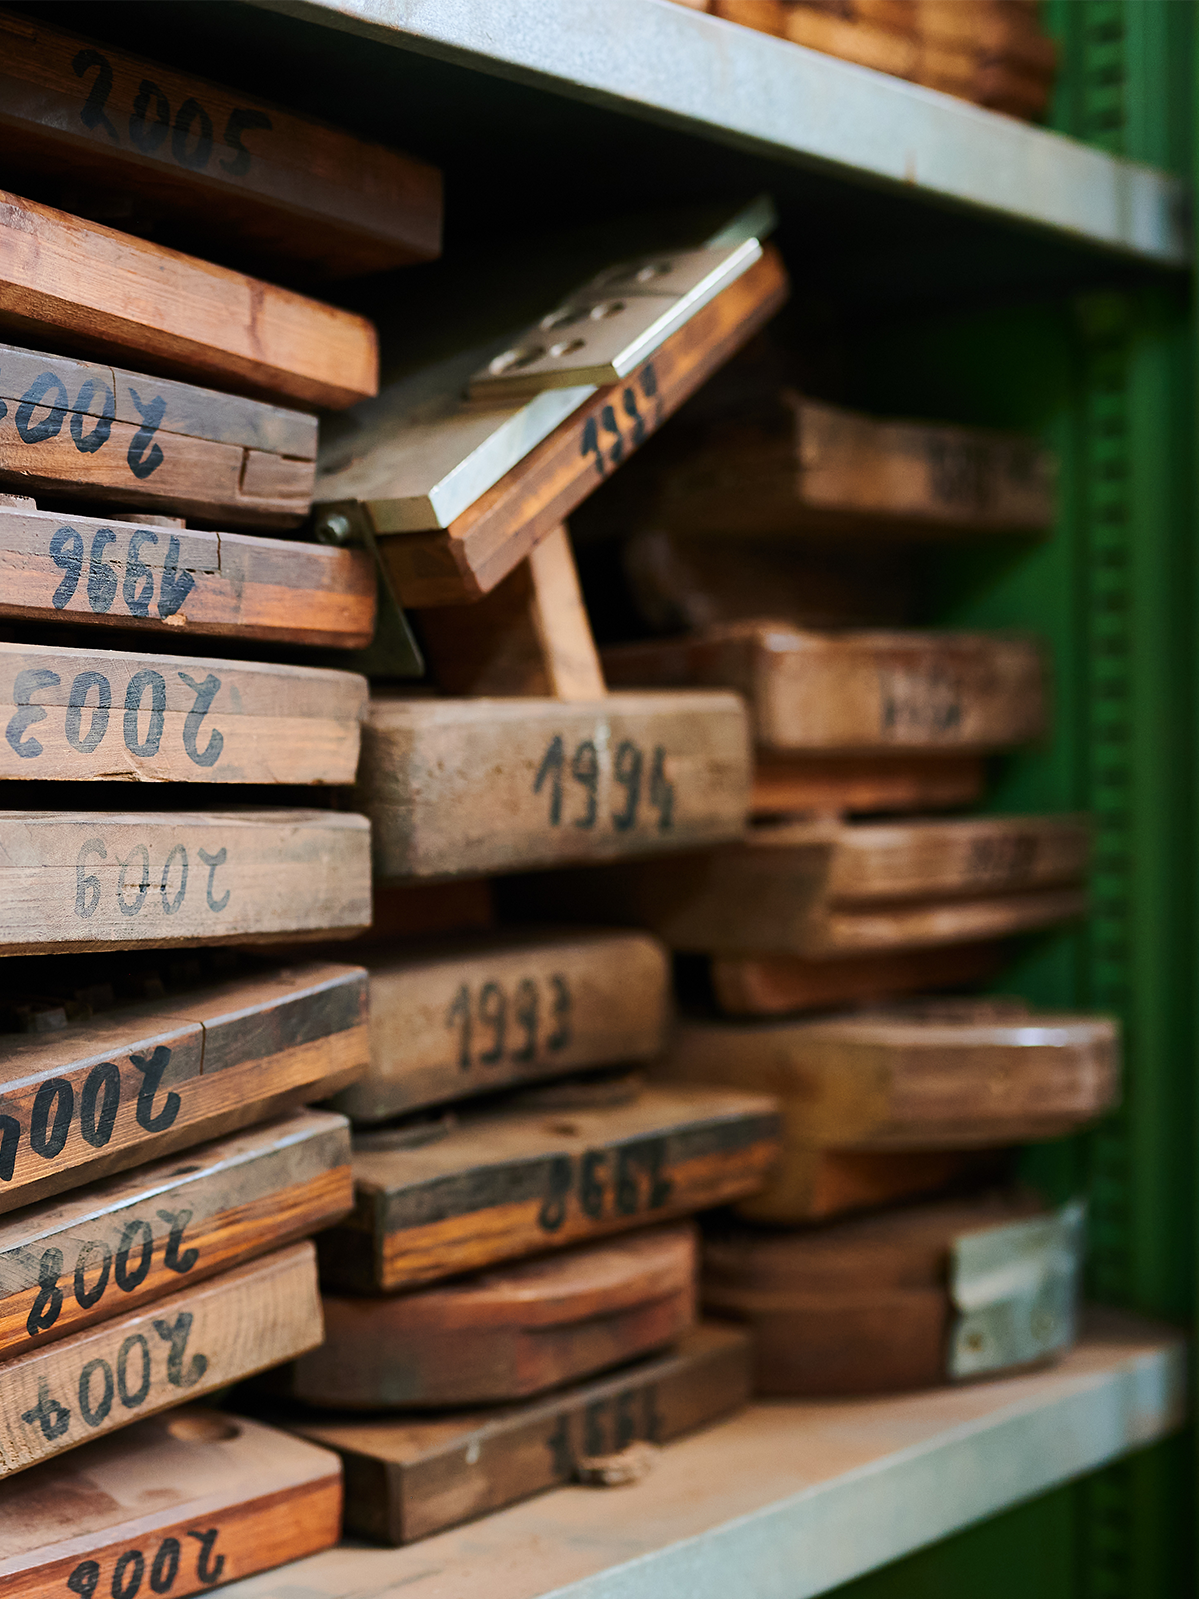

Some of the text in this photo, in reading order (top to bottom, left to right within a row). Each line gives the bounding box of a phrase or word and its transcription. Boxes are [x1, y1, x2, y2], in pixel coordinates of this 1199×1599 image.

[72, 49, 273, 176] 2005
[49, 526, 195, 619] 1996
[5, 669, 225, 767] 2003
[534, 736, 674, 831] 1994
[74, 839, 230, 918] 2009
[444, 972, 572, 1074] 1993
[26, 1209, 199, 1336] 2008
